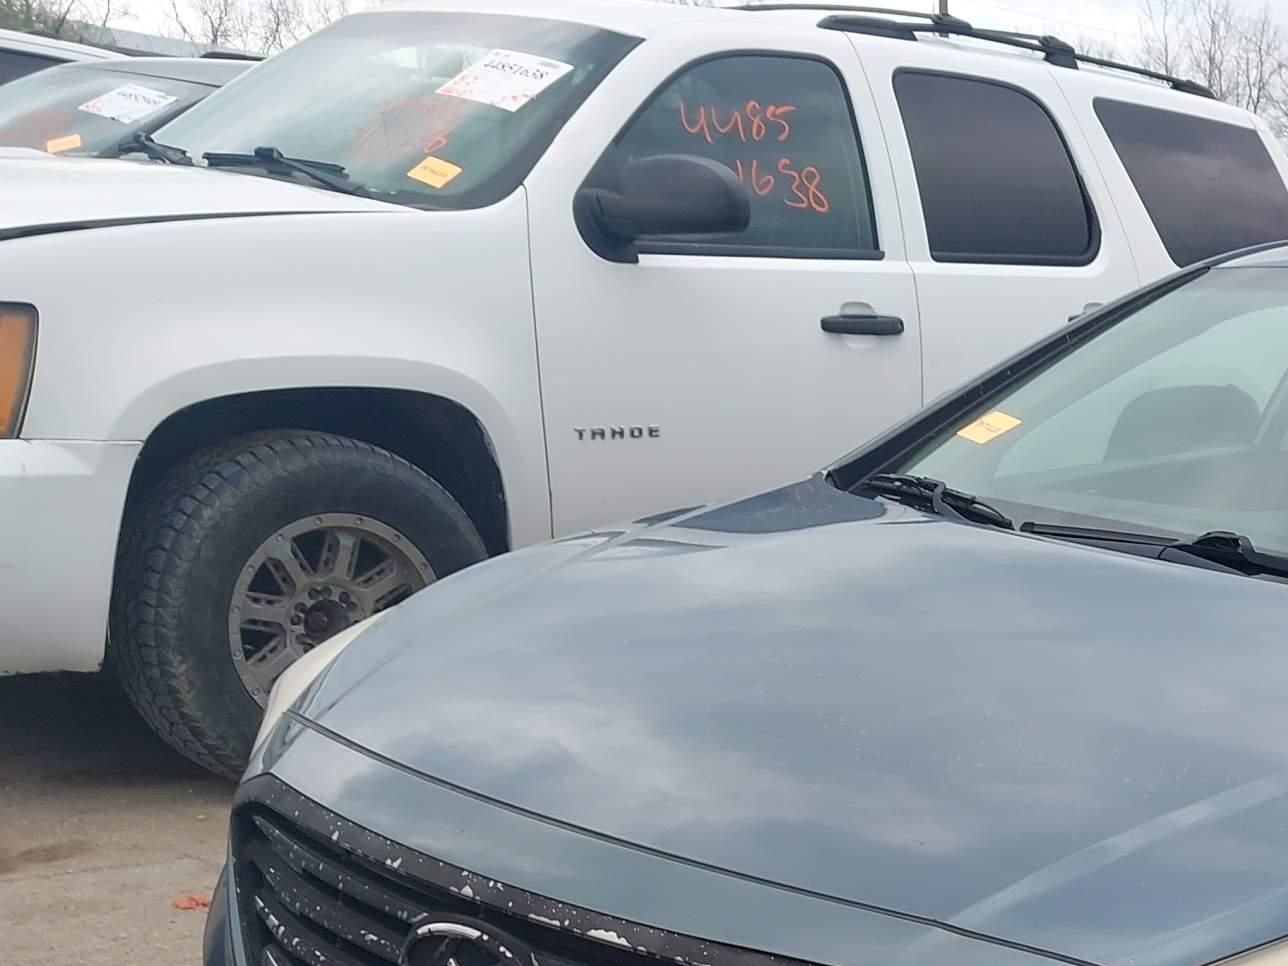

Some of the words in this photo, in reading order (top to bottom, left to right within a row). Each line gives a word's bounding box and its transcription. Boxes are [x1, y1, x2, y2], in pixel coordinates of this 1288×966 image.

[679, 99, 796, 144] 4485
[735, 158, 829, 212] 1638
[573, 425, 661, 441] TAHOE
